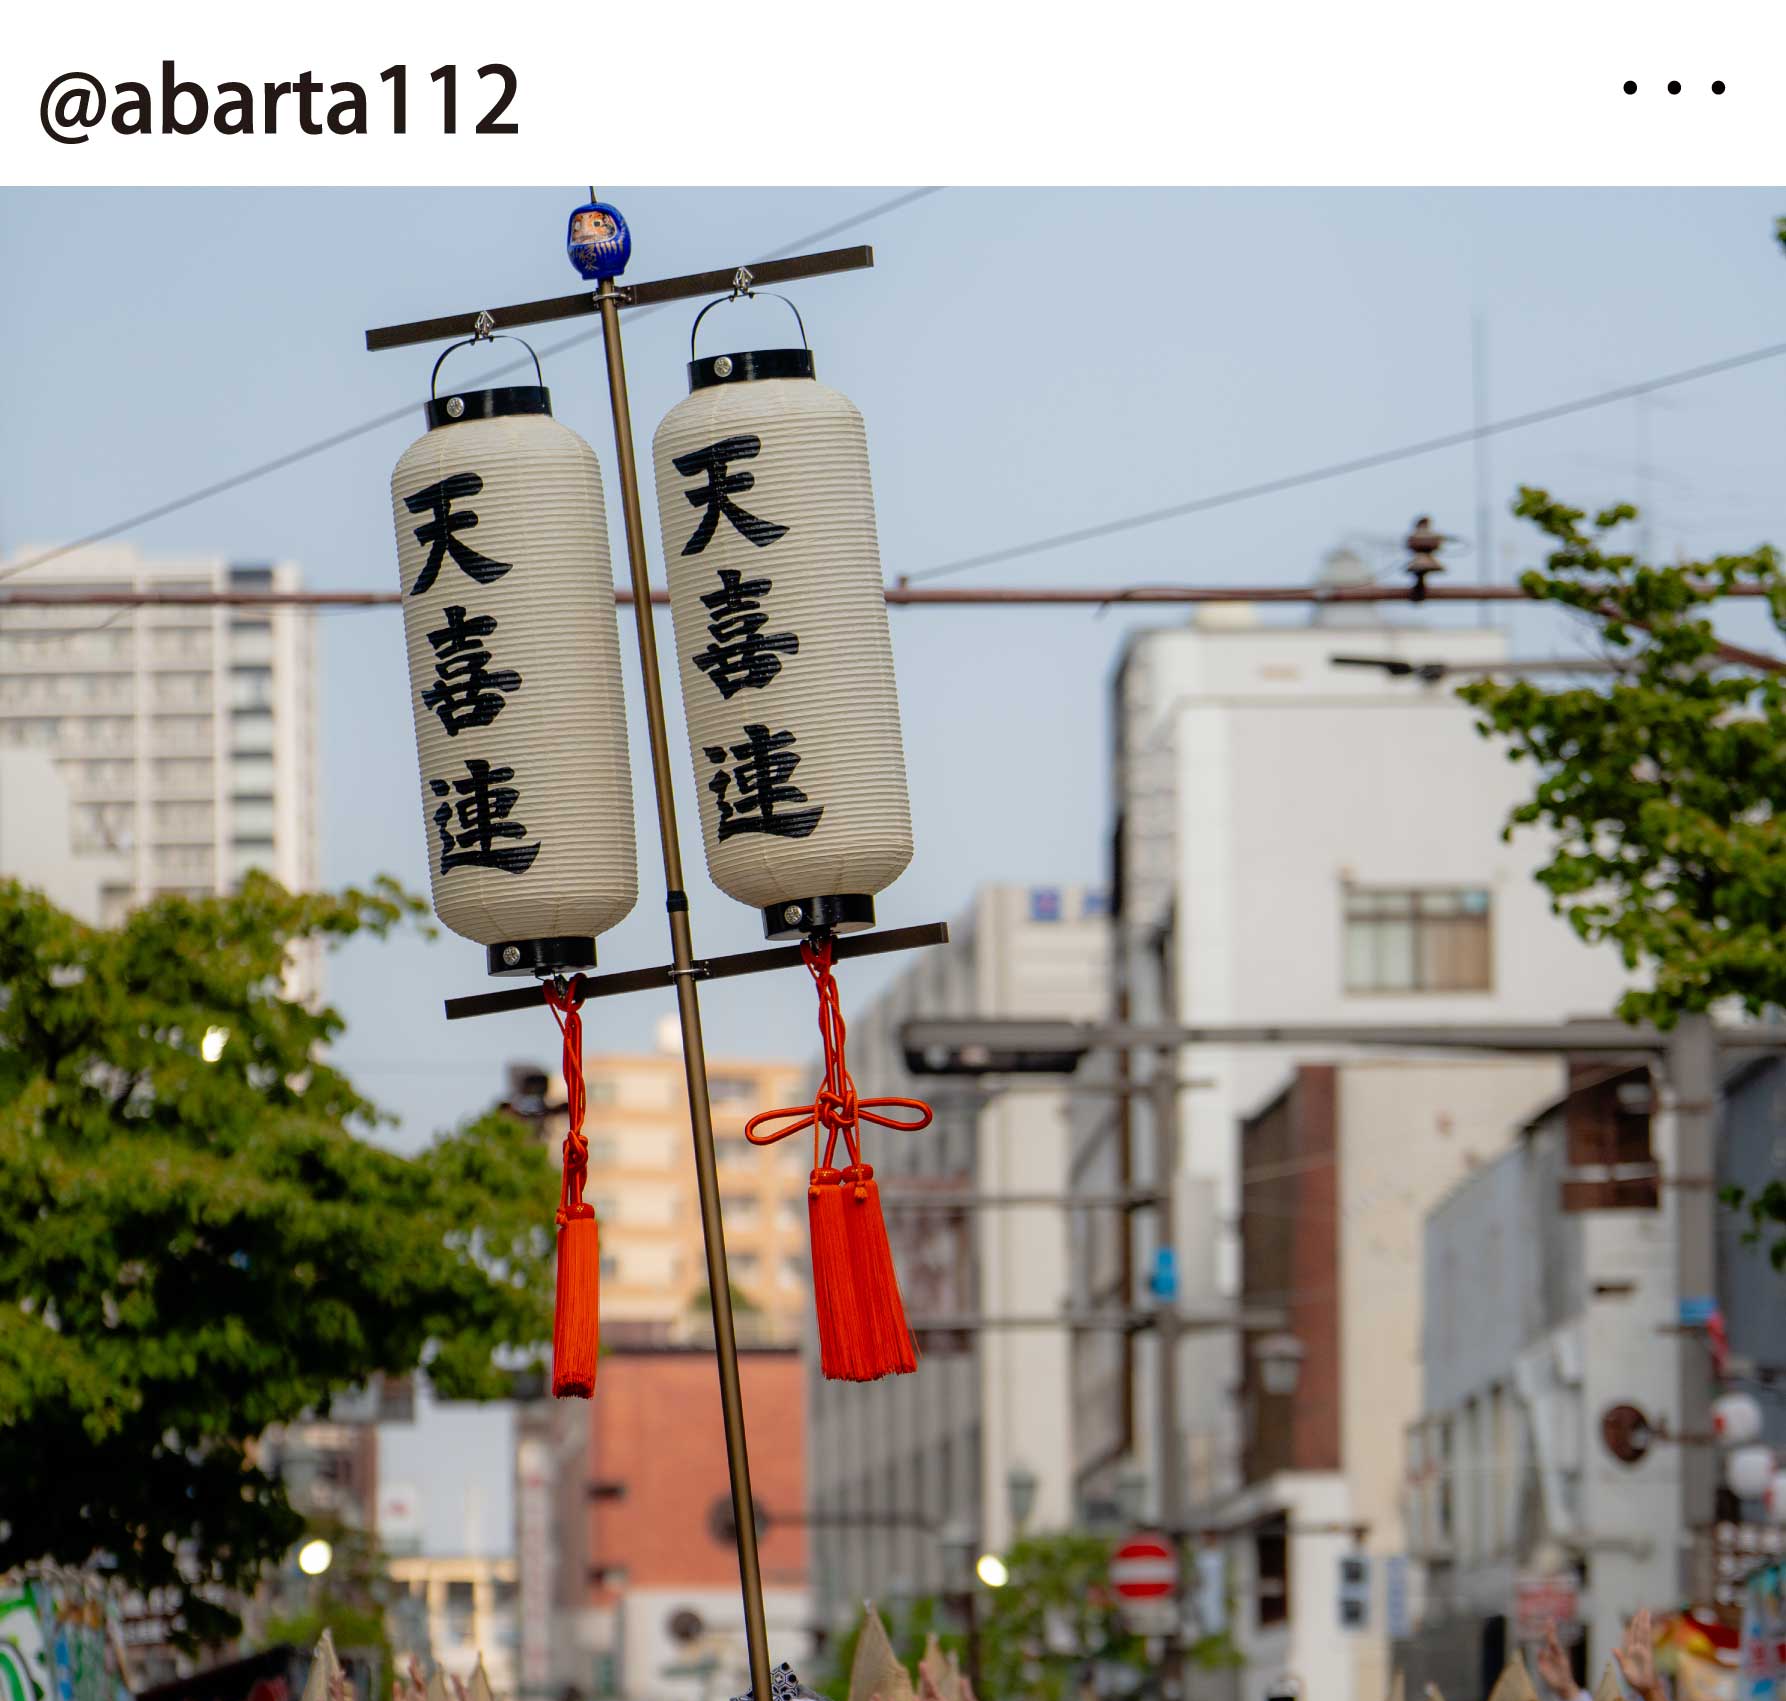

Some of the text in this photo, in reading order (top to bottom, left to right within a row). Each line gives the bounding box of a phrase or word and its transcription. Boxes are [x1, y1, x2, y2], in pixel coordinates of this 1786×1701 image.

[403, 472, 541, 875] 天喜連
[668, 435, 824, 845] 天喜連
